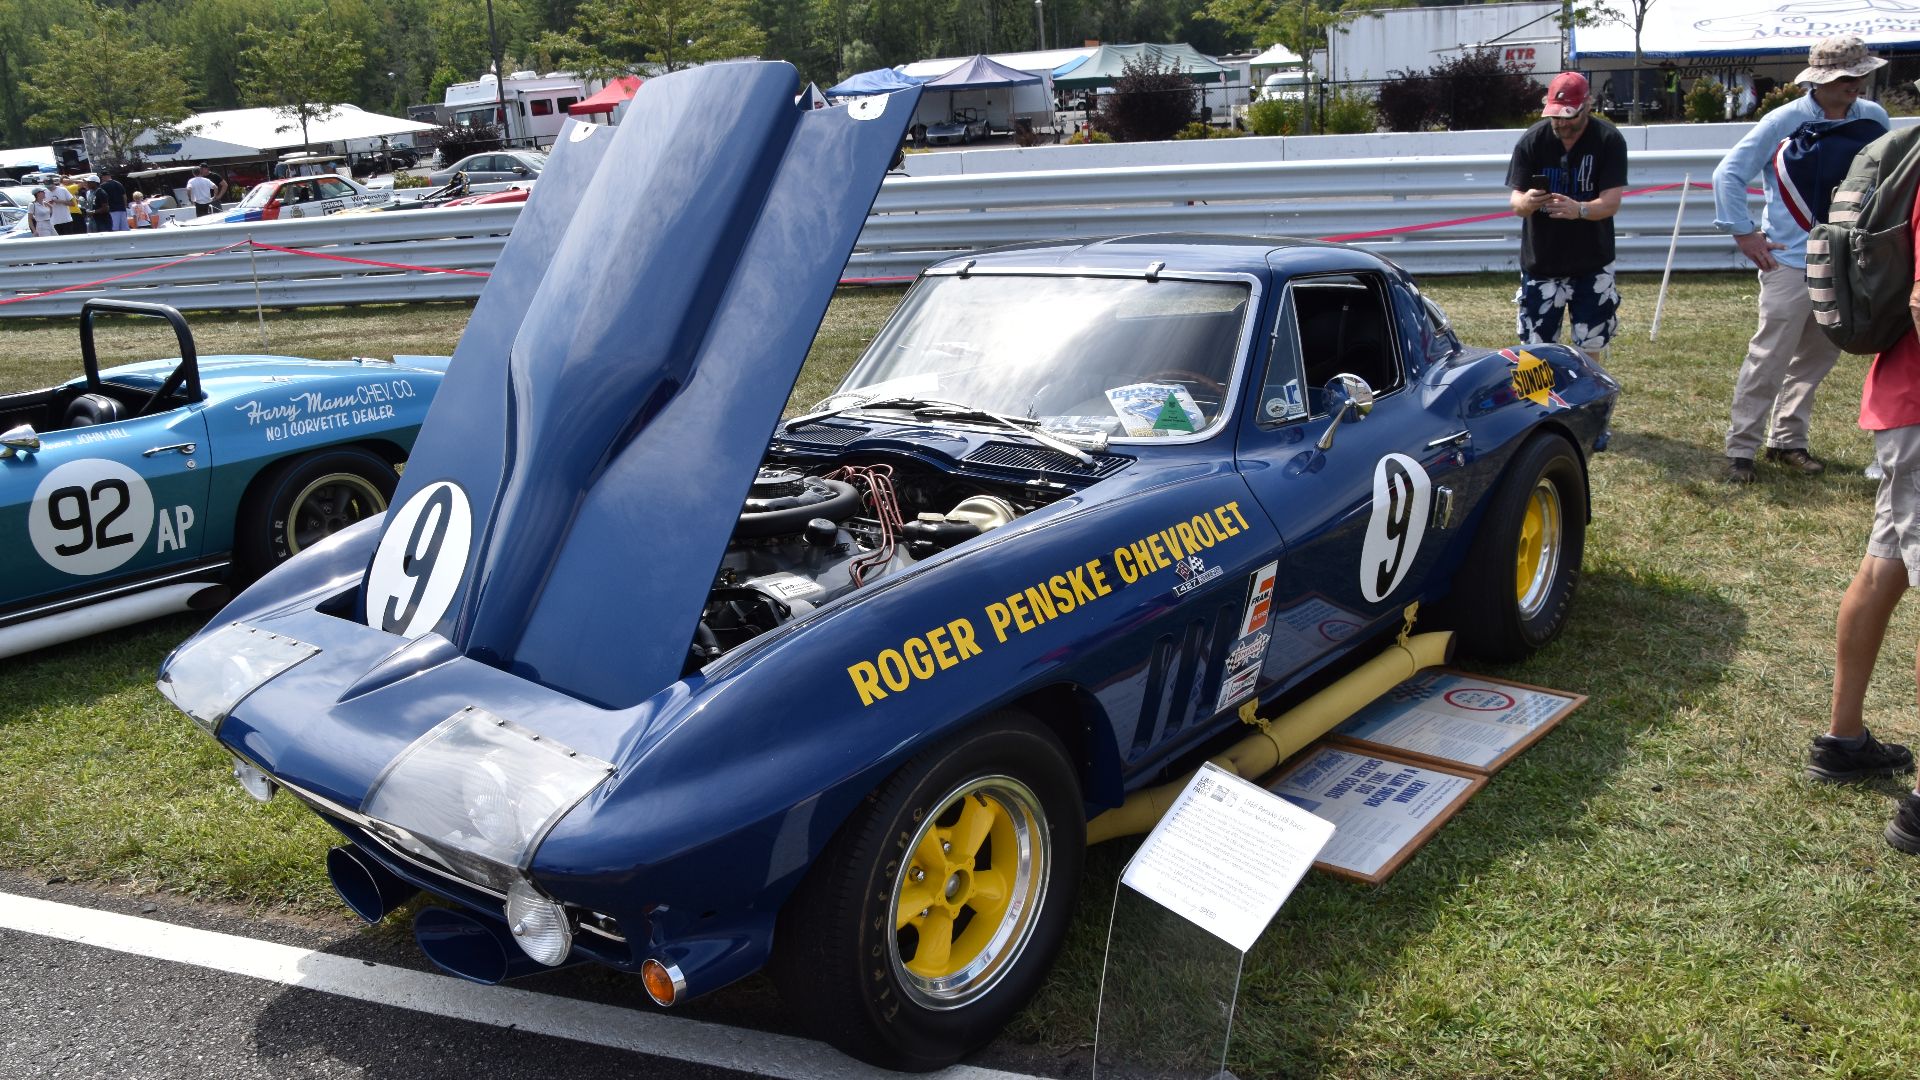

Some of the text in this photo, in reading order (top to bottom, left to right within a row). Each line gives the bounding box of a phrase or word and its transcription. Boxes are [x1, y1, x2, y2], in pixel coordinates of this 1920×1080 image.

[1505, 47, 1536, 60] KTR
[1577, 154, 1594, 192] 42
[321, 201, 344, 209] DEKRA
[1511, 360, 1555, 398] SUNOCO
[234, 379, 416, 426] Harry Mann CHEV. CO.
[290, 412, 350, 437] CORVETTE
[352, 404, 395, 425] DEALER
[76, 428, 131, 445] JOHN HILL
[48, 478, 134, 557] 92
[157, 504, 195, 554] AP
[1375, 457, 1415, 598] 9
[382, 484, 454, 636] 9
[1180, 579, 1197, 592] 427
[1250, 590, 1270, 606] FRAM
[847, 500, 1251, 708] ROGER PENSKE CHEVROLET
[1200, 775, 1216, 788] LIME
[1323, 776, 1361, 799] SUNOCO
[1350, 758, 1383, 778] ENTERS
[1362, 786, 1397, 808] RACING
[1387, 772, 1414, 788] WITH
[1365, 770, 1392, 785] TIME
[1391, 779, 1431, 804] WINNER!
